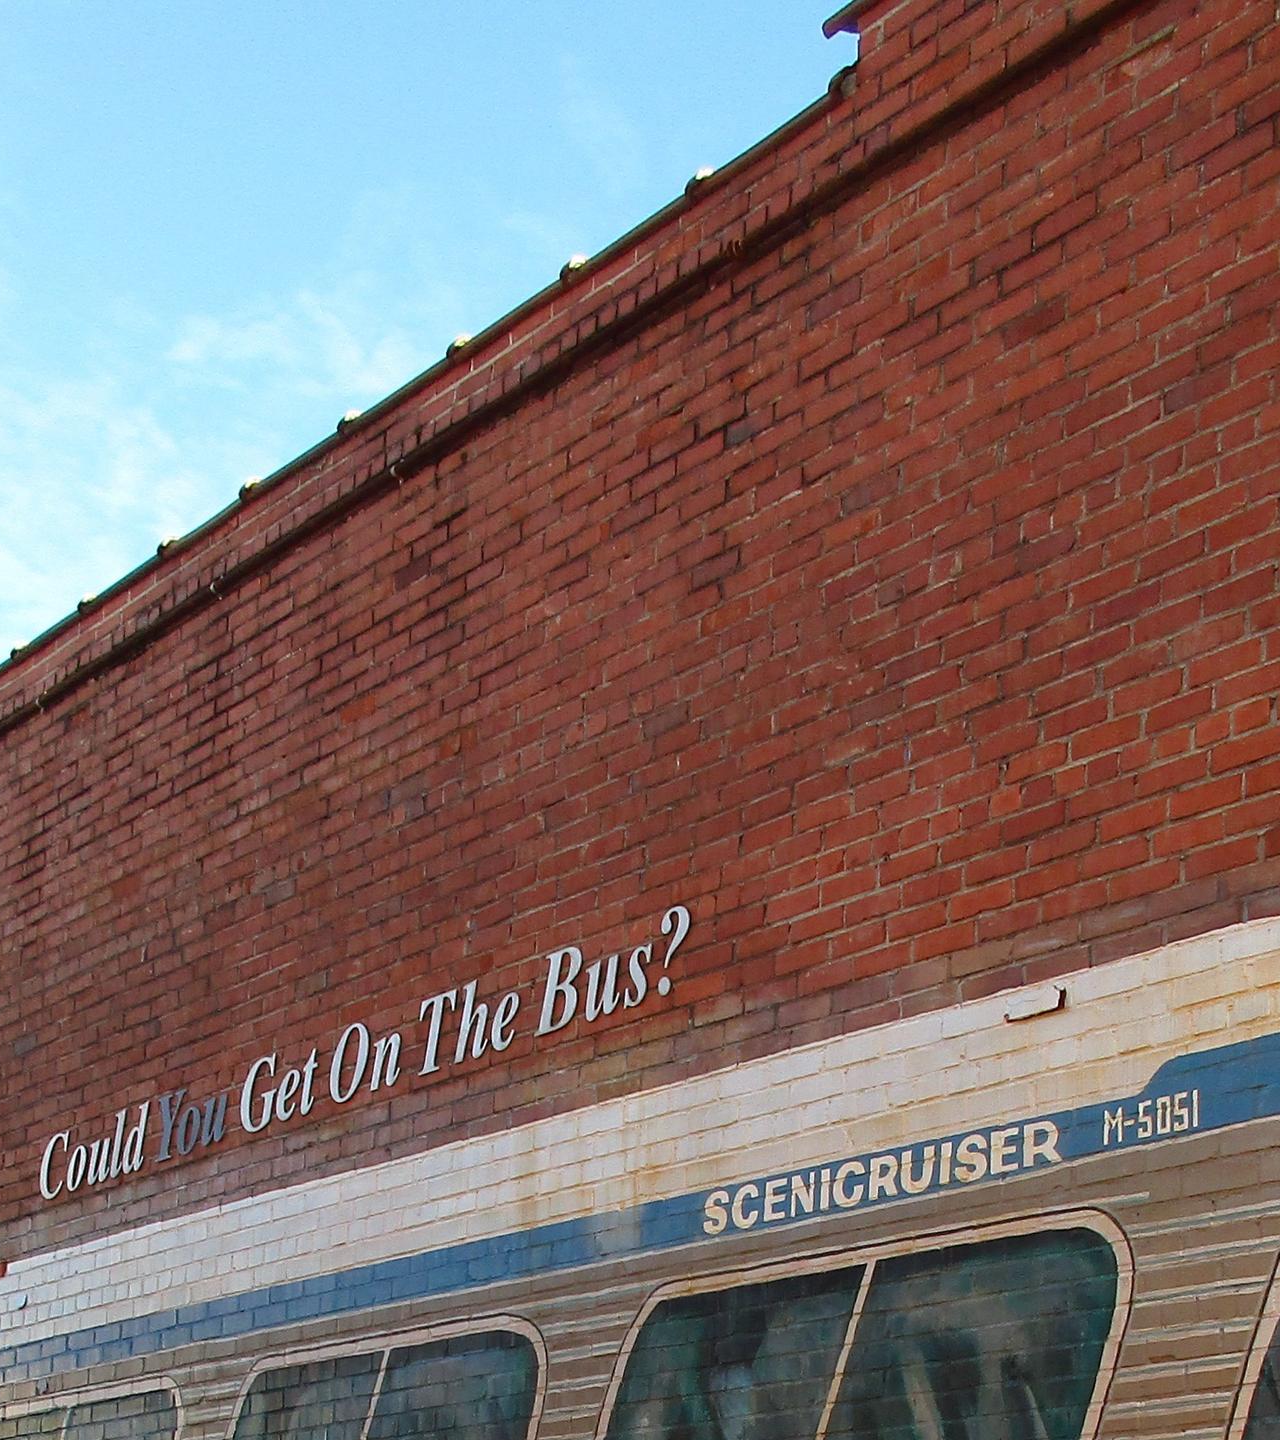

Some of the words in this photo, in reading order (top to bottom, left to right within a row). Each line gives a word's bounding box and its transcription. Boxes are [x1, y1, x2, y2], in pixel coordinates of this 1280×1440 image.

[40, 1099, 148, 1200] Could
[155, 1088, 228, 1163] You
[240, 1047, 318, 1133] Get
[329, 1021, 402, 1104] On
[417, 978, 519, 1077] The
[534, 905, 691, 1038] Bus?
[1103, 1089, 1200, 1146] M-5051
[703, 1120, 1063, 1235] SCENICRUISER
